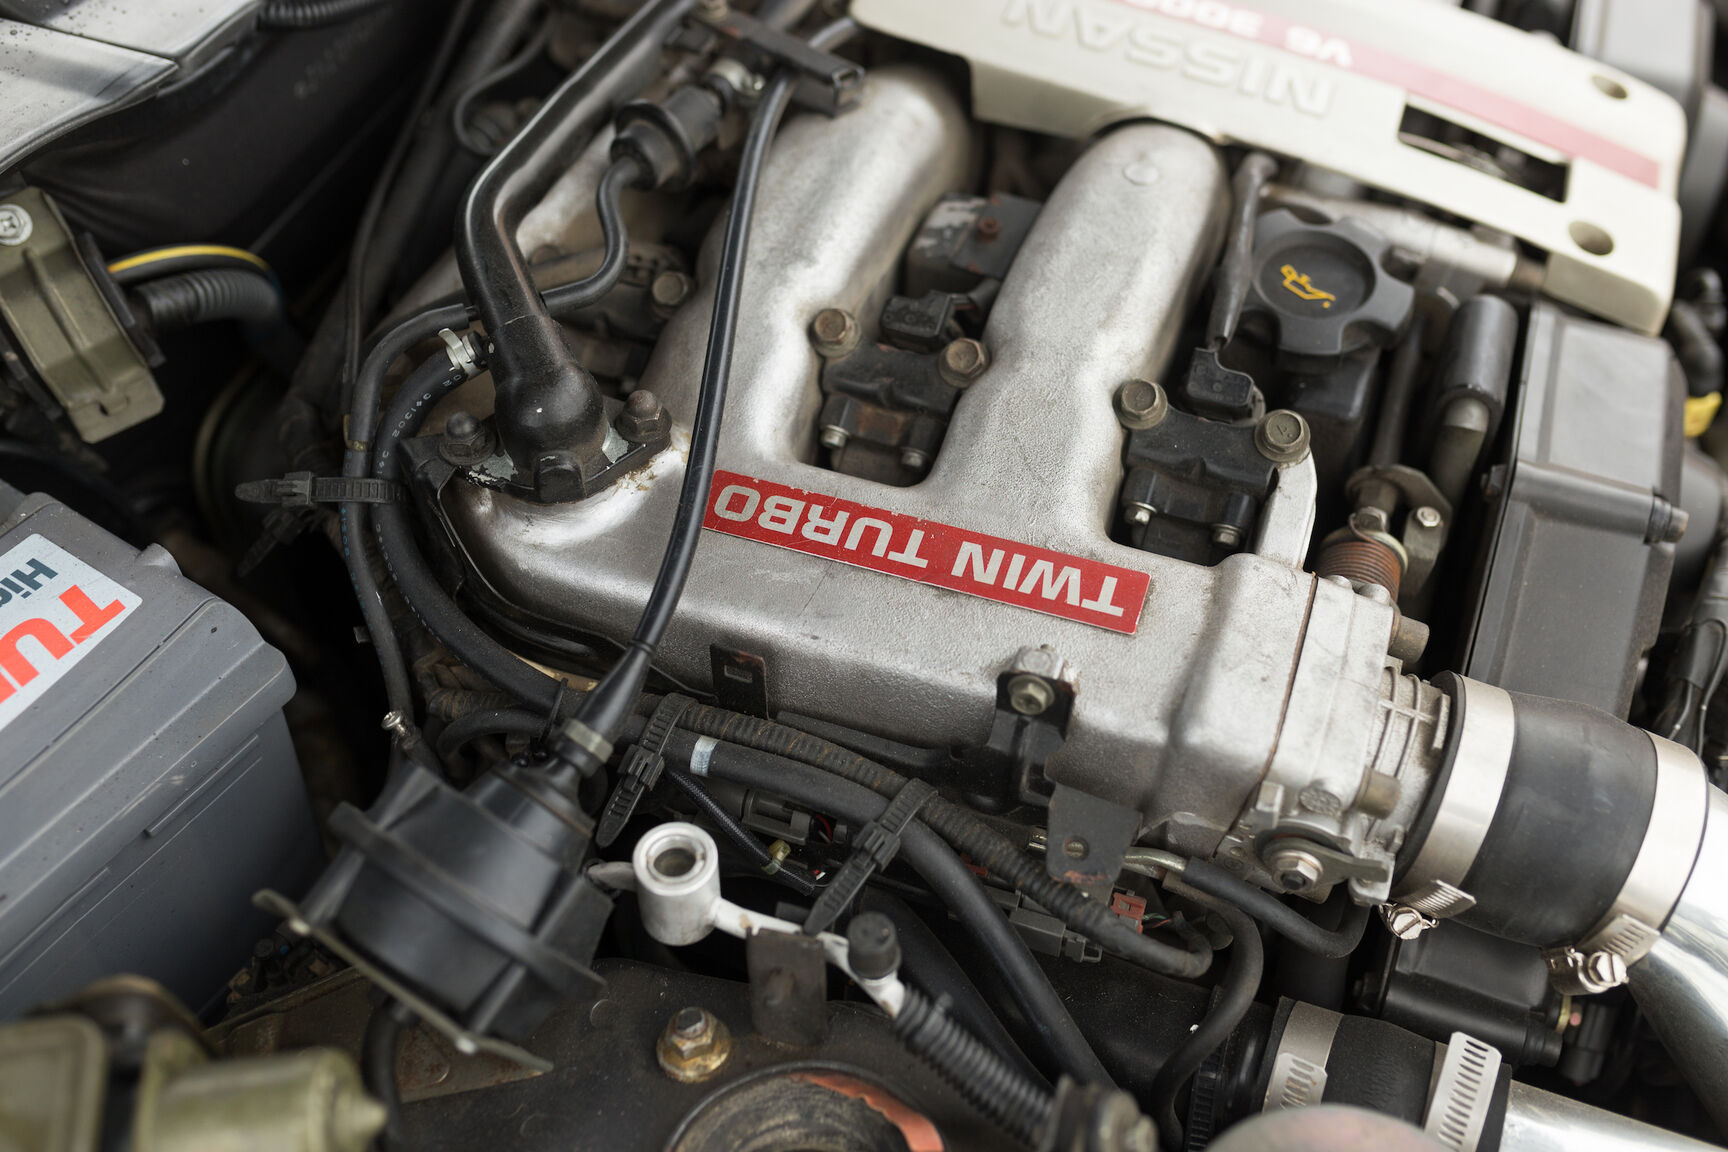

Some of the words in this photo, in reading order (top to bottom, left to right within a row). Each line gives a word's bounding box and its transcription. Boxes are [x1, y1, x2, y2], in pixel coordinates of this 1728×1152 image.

[1001, 0, 1336, 118] NISSAN
[1285, 24, 1353, 67] V6
[714, 484, 929, 568] TURBO
[951, 541, 1124, 617] TWIN
